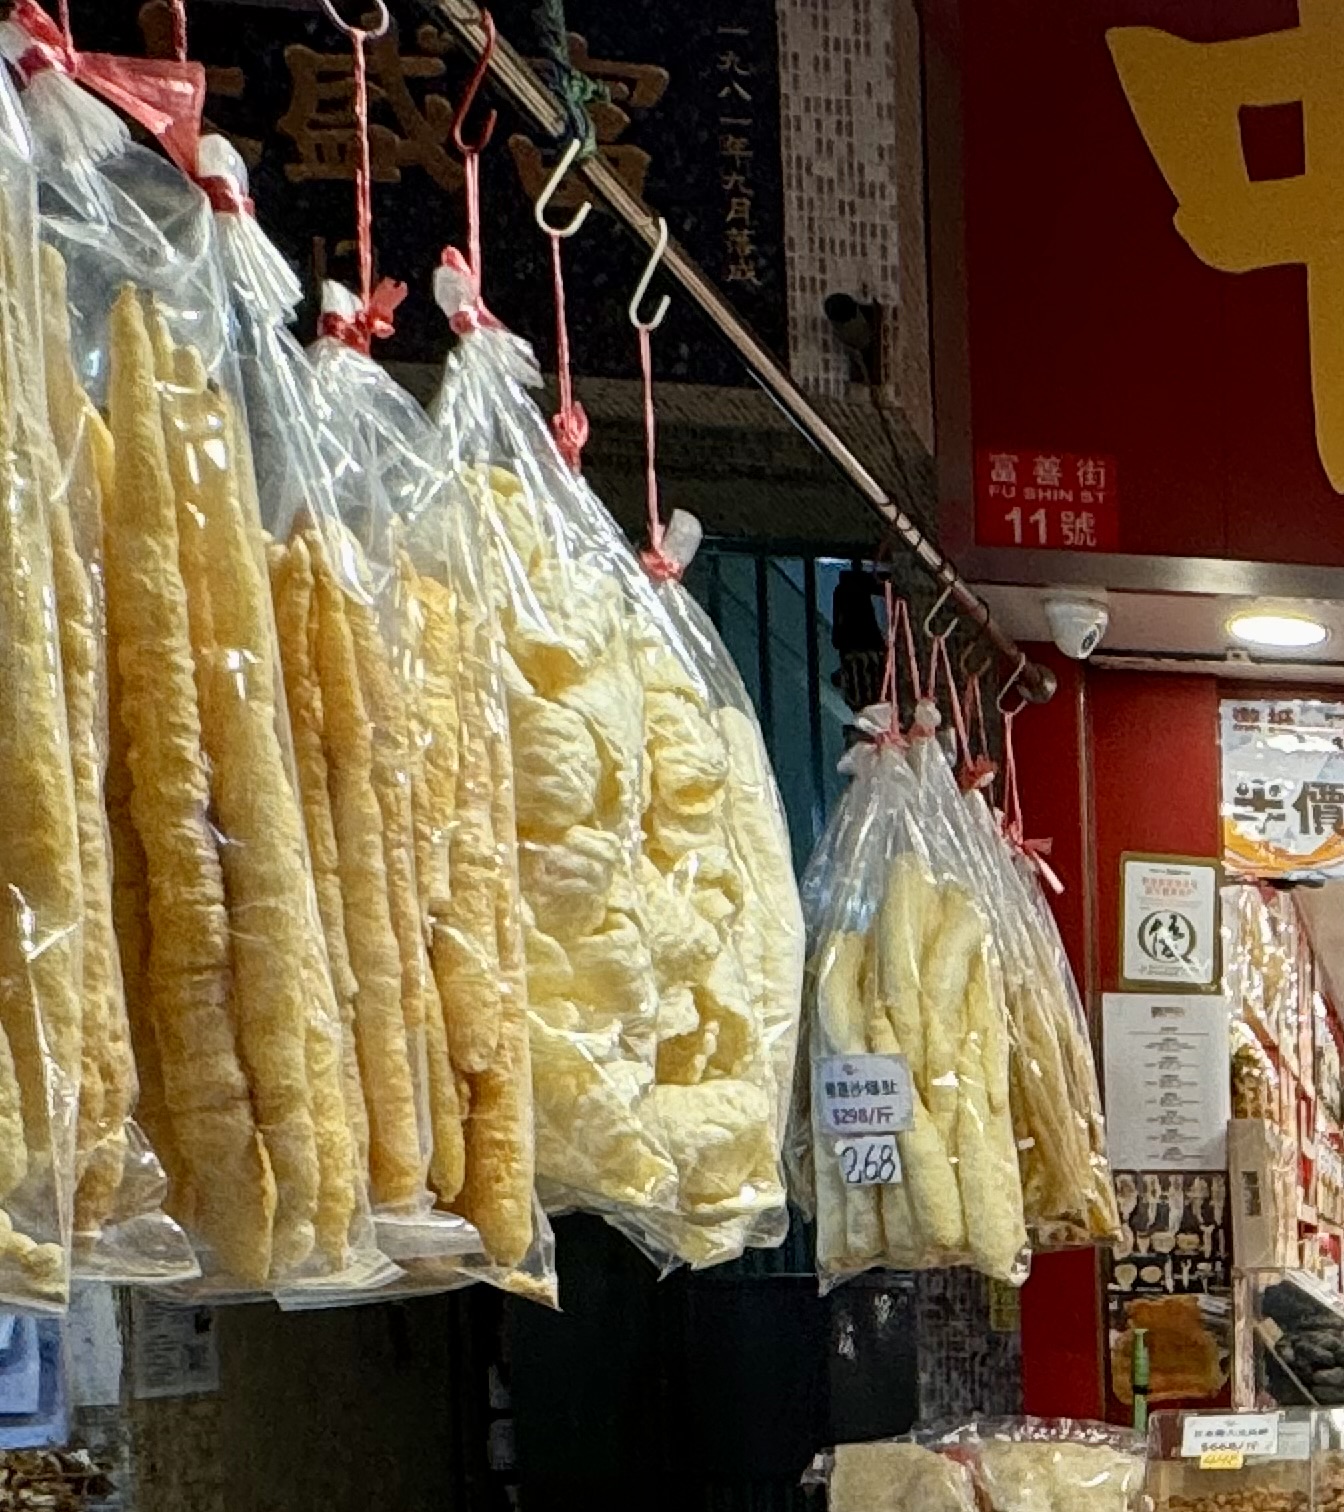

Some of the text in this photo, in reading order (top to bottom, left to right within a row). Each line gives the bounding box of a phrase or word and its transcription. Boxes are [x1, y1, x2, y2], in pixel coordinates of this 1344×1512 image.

[988, 452, 1107, 488] 富善街
[988, 486, 1106, 503] FU SHIN ST
[1003, 507, 1098, 547] 11號
[840, 1144, 896, 1184] 268
